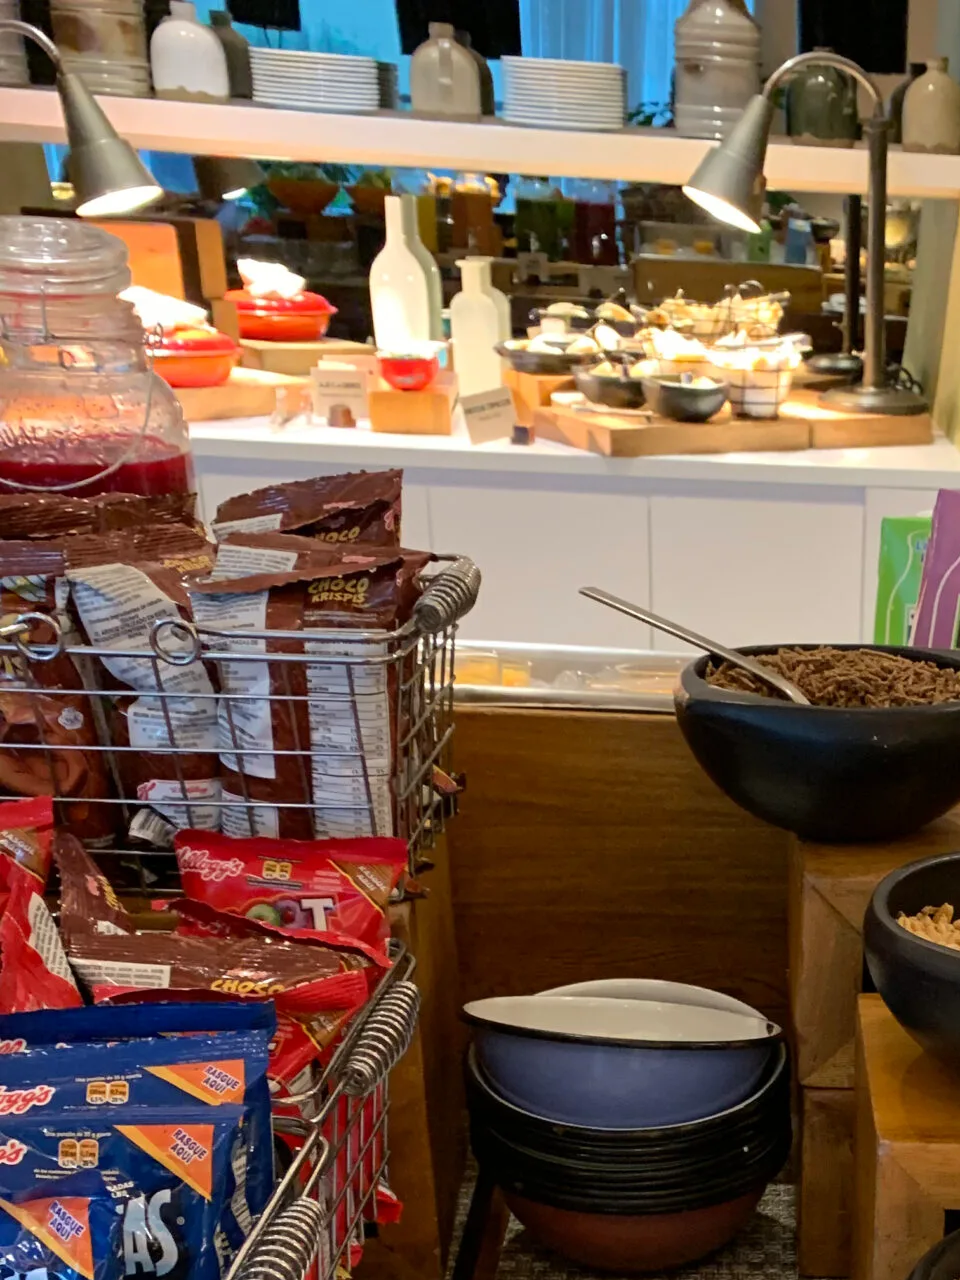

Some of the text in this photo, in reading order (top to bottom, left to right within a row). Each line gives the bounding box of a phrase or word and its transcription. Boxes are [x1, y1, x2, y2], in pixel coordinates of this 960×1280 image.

[308, 578, 370, 595] CHOCO
[311, 592, 368, 604] KRISPIS
[204, 1065, 241, 1091] RASGUE
[172, 1128, 208, 1160] RASGUE
[49, 1200, 85, 1236] RASGUE
